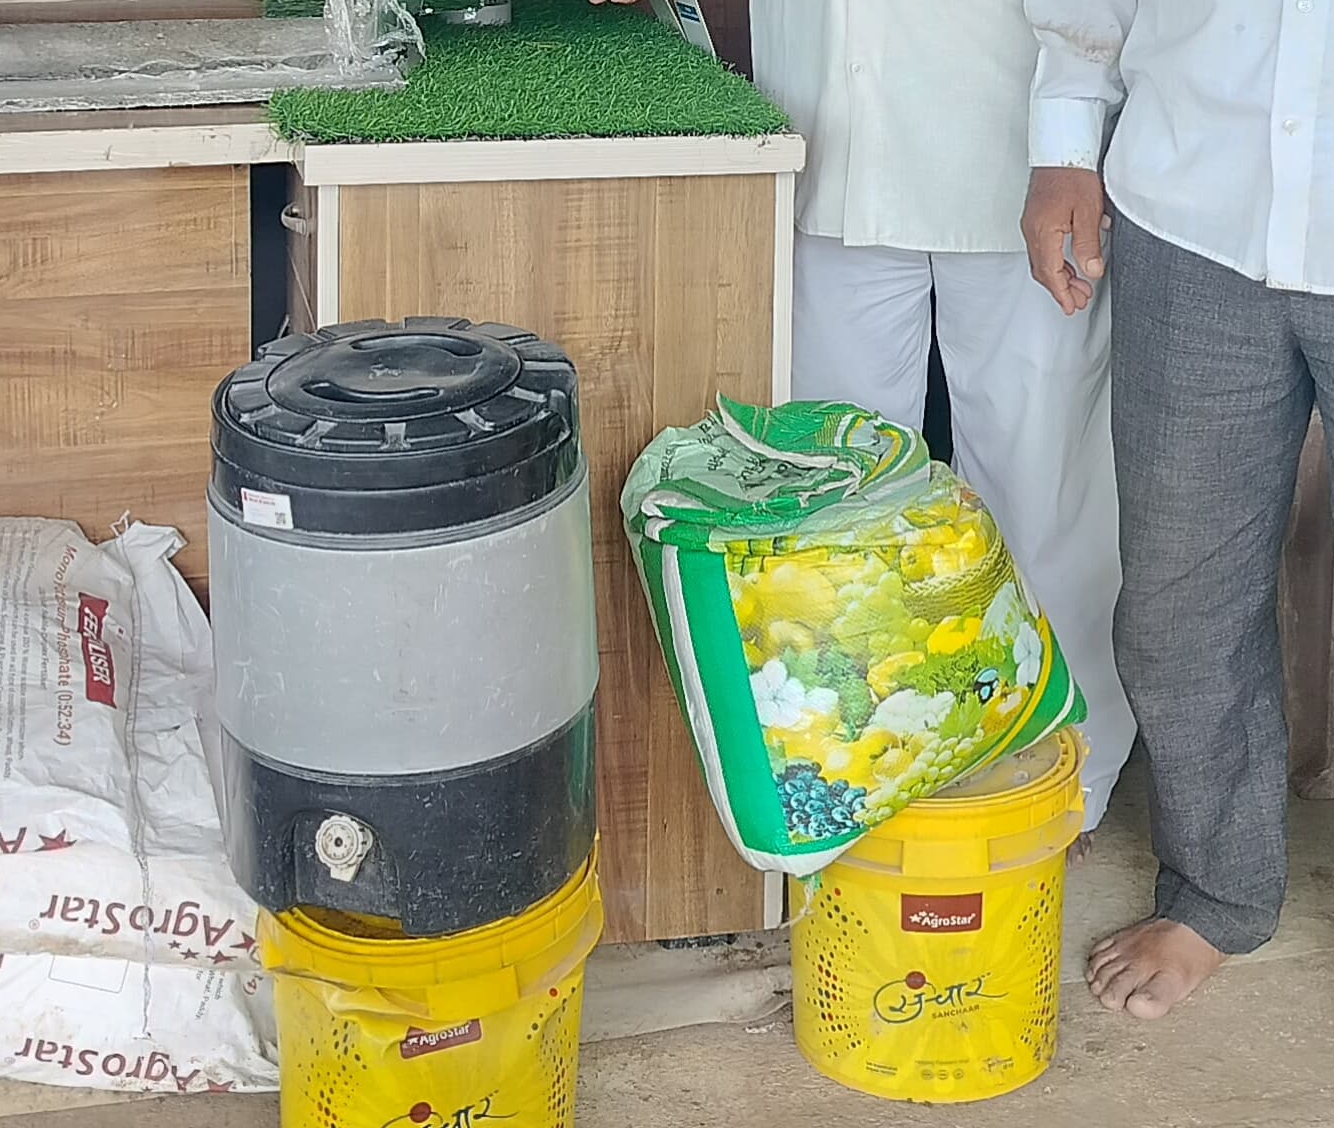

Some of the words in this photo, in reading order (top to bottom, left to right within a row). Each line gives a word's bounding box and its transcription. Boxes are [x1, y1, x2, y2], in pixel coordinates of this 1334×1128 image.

[53, 689, 74, 748] (0:52:34)
[39, 894, 236, 946] AgroStar
[921, 912, 976, 928] AgroStar
[931, 1003, 981, 1020] SANCHAAR
[16, 1036, 201, 1089] AgroStar
